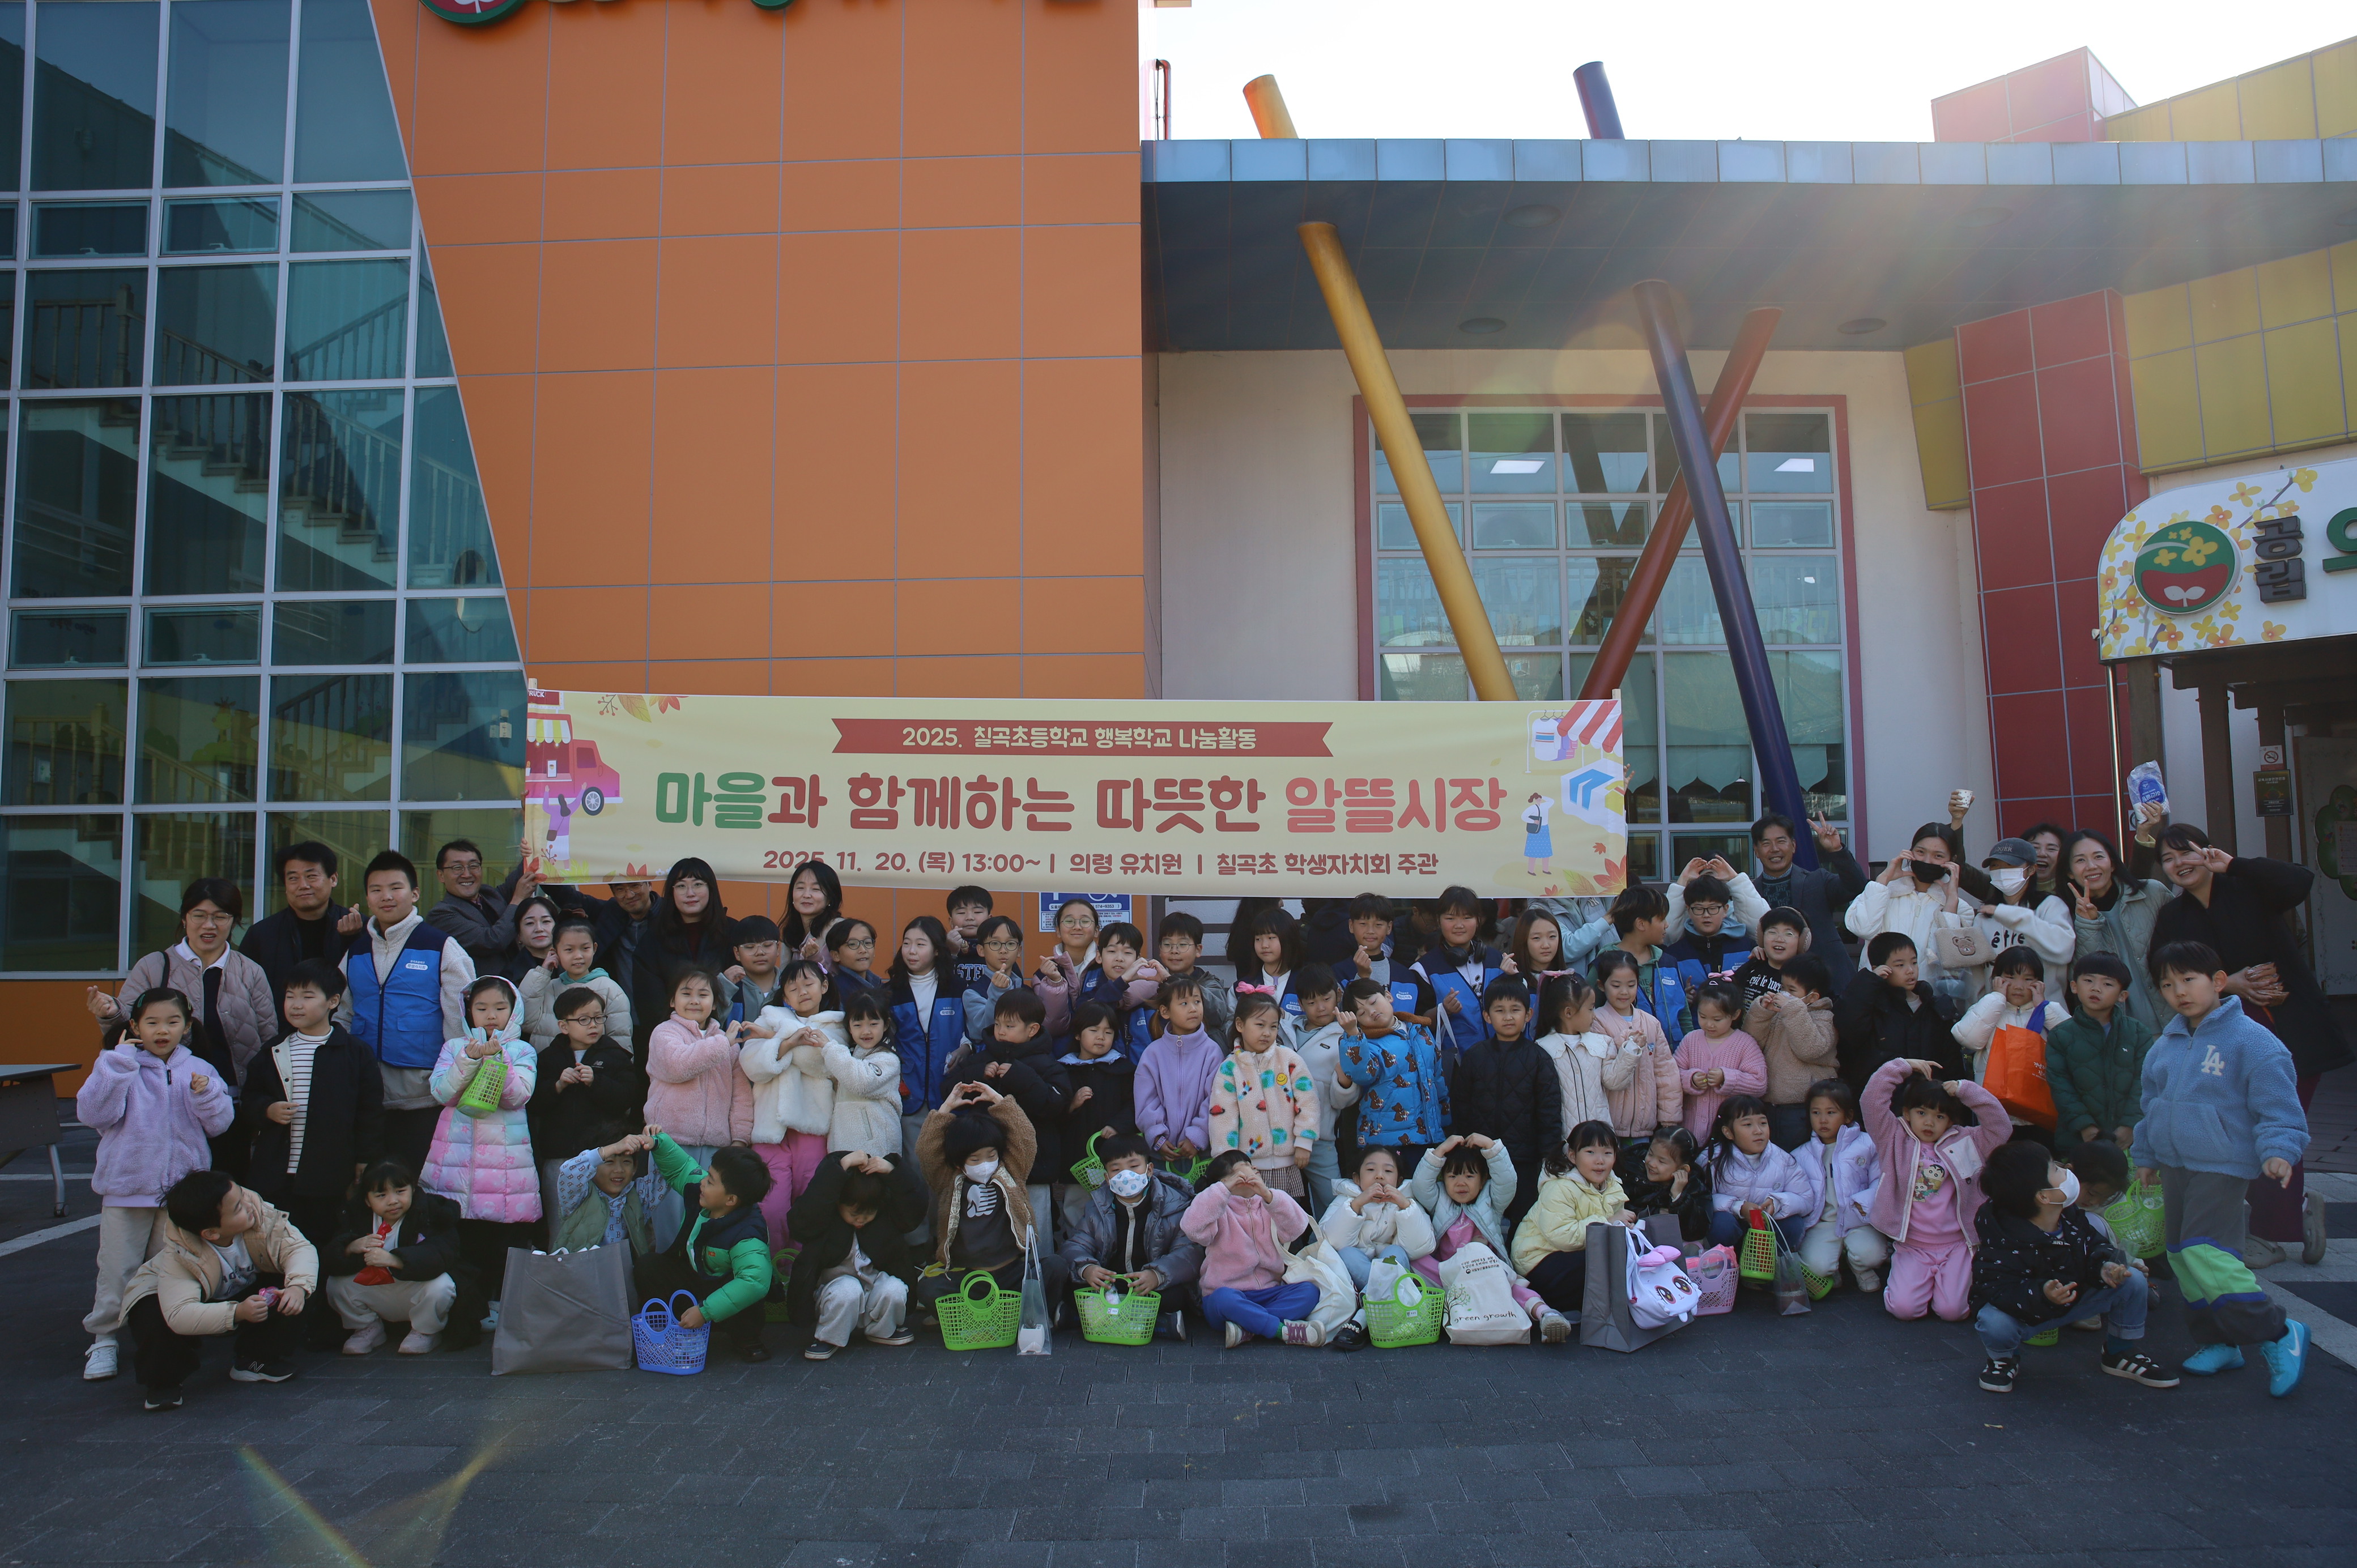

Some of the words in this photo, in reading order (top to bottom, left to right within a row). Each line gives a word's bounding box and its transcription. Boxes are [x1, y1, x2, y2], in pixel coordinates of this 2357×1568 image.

[902, 726, 963, 748] 2025.
[974, 725, 1089, 749] 칠곡초등학교
[1094, 726, 1173, 749] 행복학교
[1178, 726, 1257, 750] 나눔활동
[655, 771, 828, 830] 마을과
[848, 772, 1075, 832] 함께하는
[1097, 776, 1266, 834] 따뜻한
[1285, 777, 1508, 834] 알뜰시장
[837, 851, 862, 872] 11.
[875, 853, 911, 872] 20.
[918, 851, 955, 874] (목)
[963, 853, 1041, 873] 13:00~
[1070, 854, 1113, 875] 의령
[1120, 853, 1182, 875] 유치원
[1217, 854, 1279, 876] 칠곡초
[1284, 854, 1391, 876] 학생자치회
[1397, 854, 1439, 876] 주관
[1992, 930, 2025, 948] être
[953, 963, 985, 981] STE
[2201, 1045, 2225, 1076] LA
[1454, 1315, 1480, 1324] green
[1483, 1310, 1517, 1321] growth
